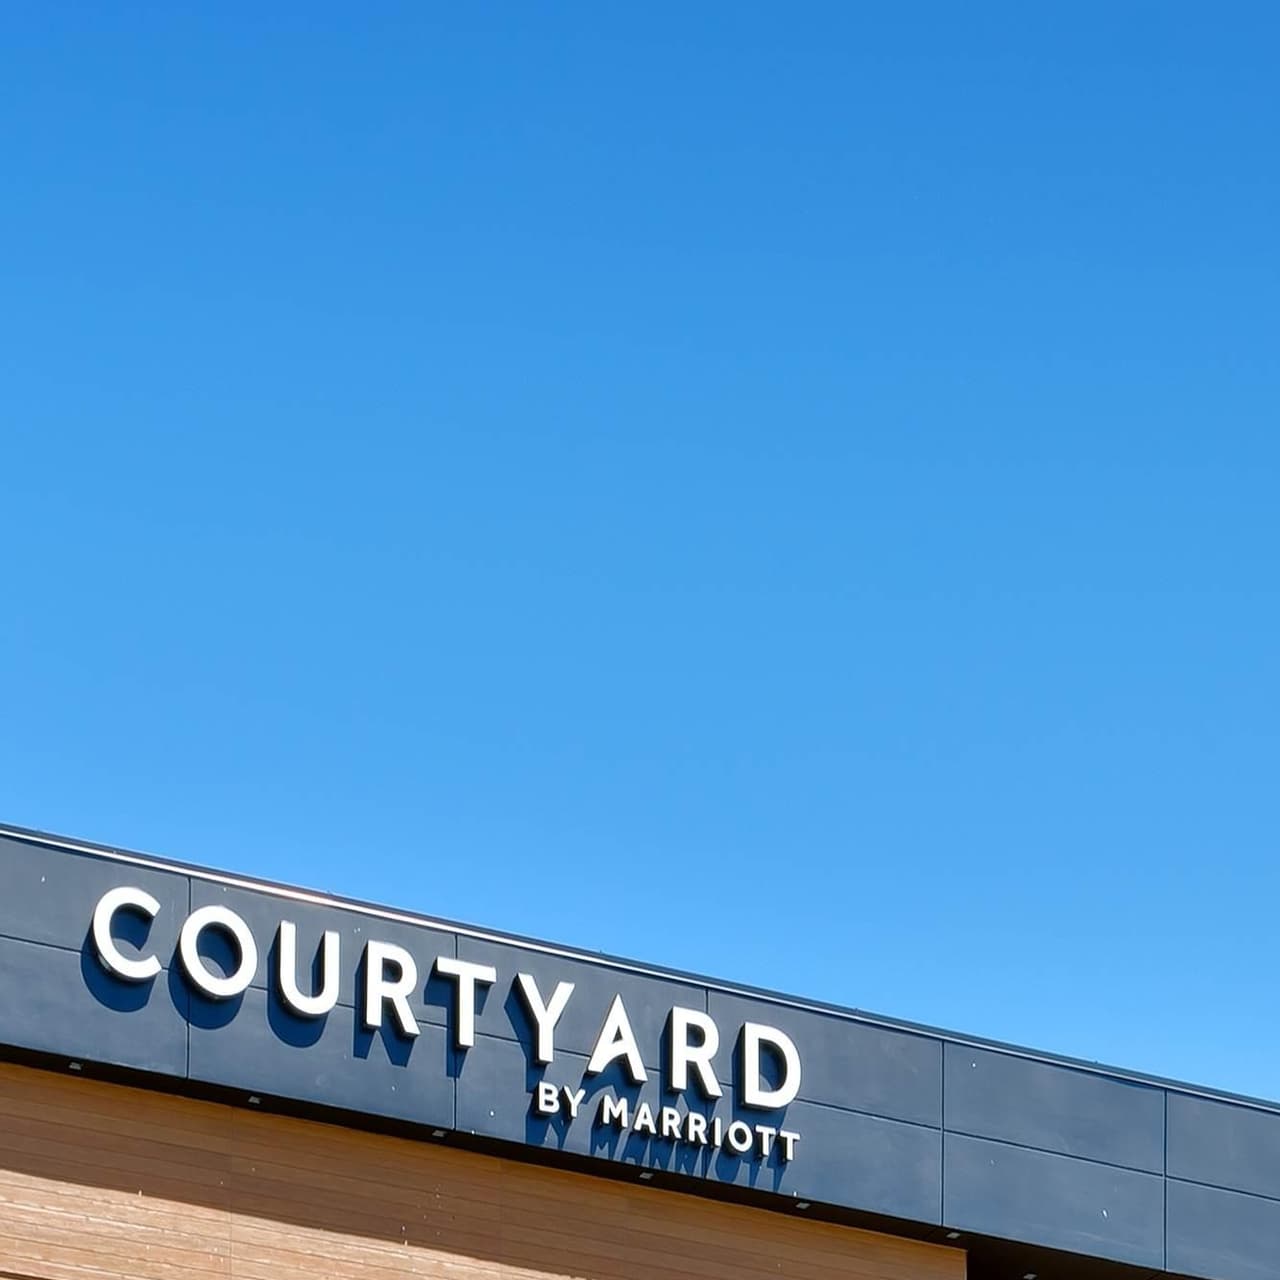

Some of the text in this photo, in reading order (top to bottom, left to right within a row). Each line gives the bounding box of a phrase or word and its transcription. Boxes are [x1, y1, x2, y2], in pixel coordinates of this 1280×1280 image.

[92, 886, 802, 1110] COURTYARD
[538, 1081, 803, 1162] BY MARRIOTT
